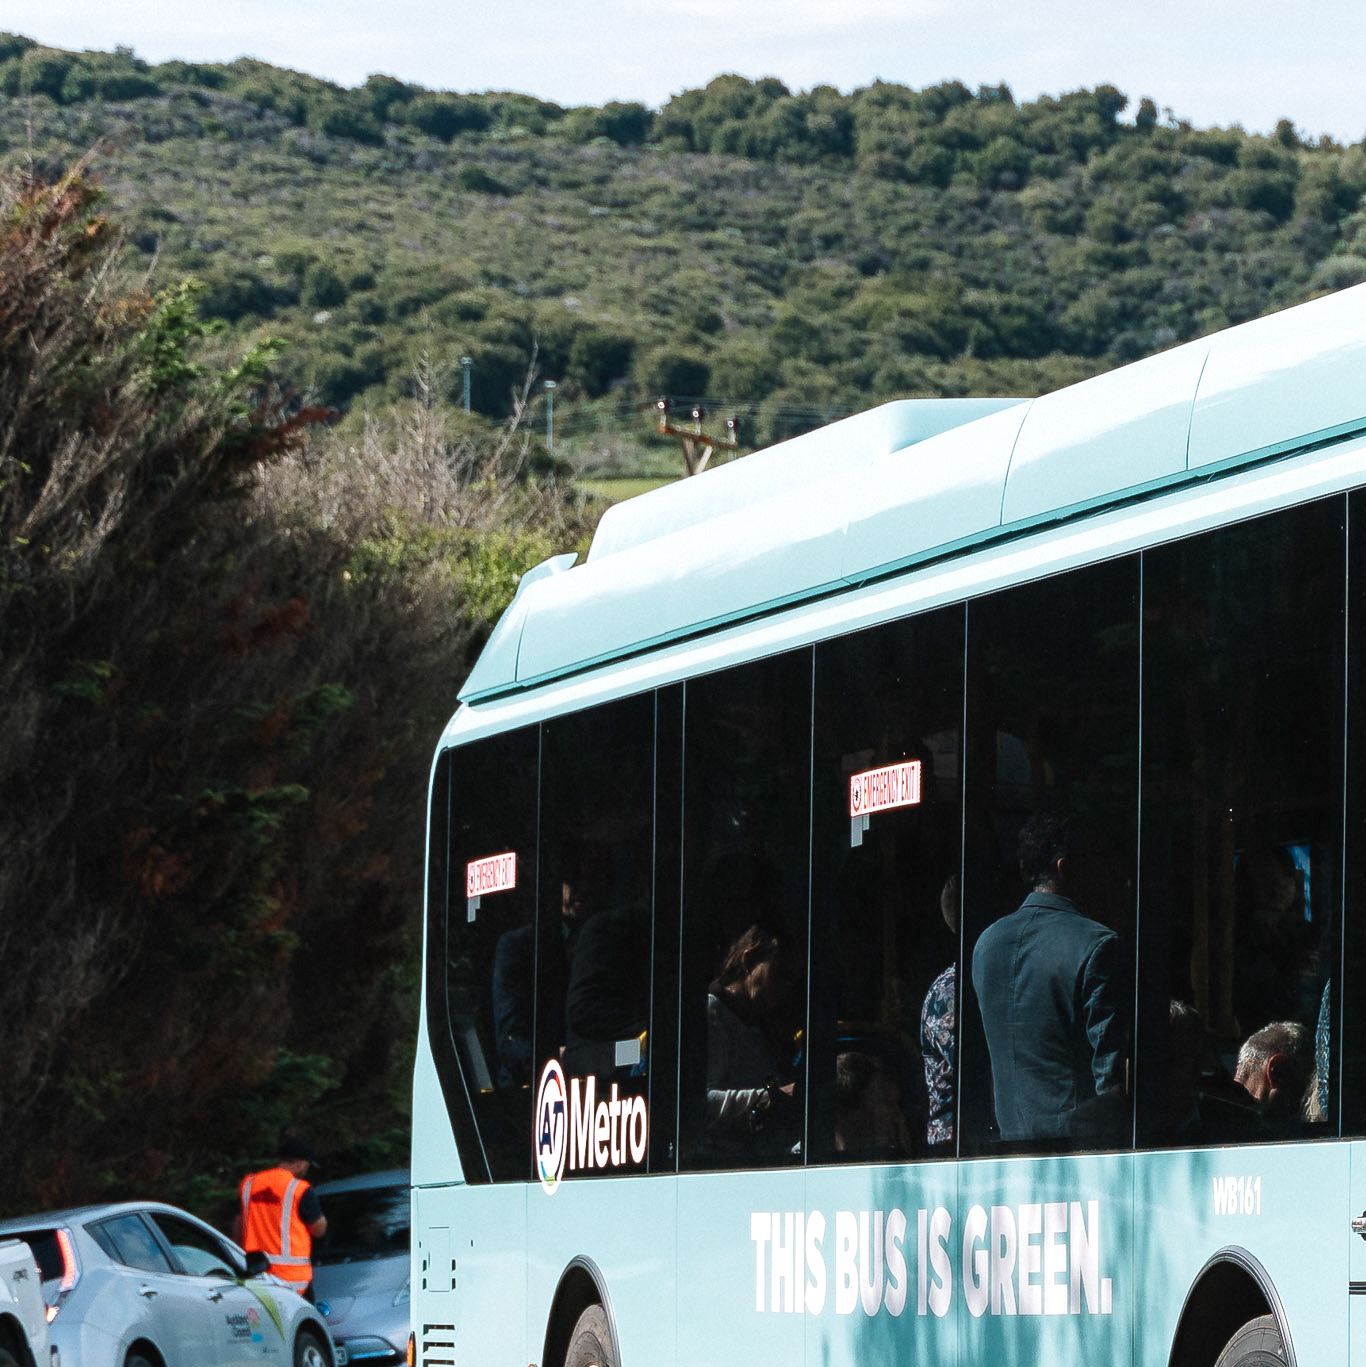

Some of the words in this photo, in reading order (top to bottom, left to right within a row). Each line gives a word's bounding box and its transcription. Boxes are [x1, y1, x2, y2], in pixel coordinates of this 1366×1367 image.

[863, 768, 899, 810] EMERGENCY
[901, 765, 915, 802] EXIT
[569, 1075, 647, 1170] Metro
[1213, 1176, 1262, 1215] WB161
[750, 1209, 827, 1317] THIS
[834, 1209, 907, 1317] BUS
[917, 1206, 952, 1318] IS
[962, 1199, 1113, 1319] GREEN.
